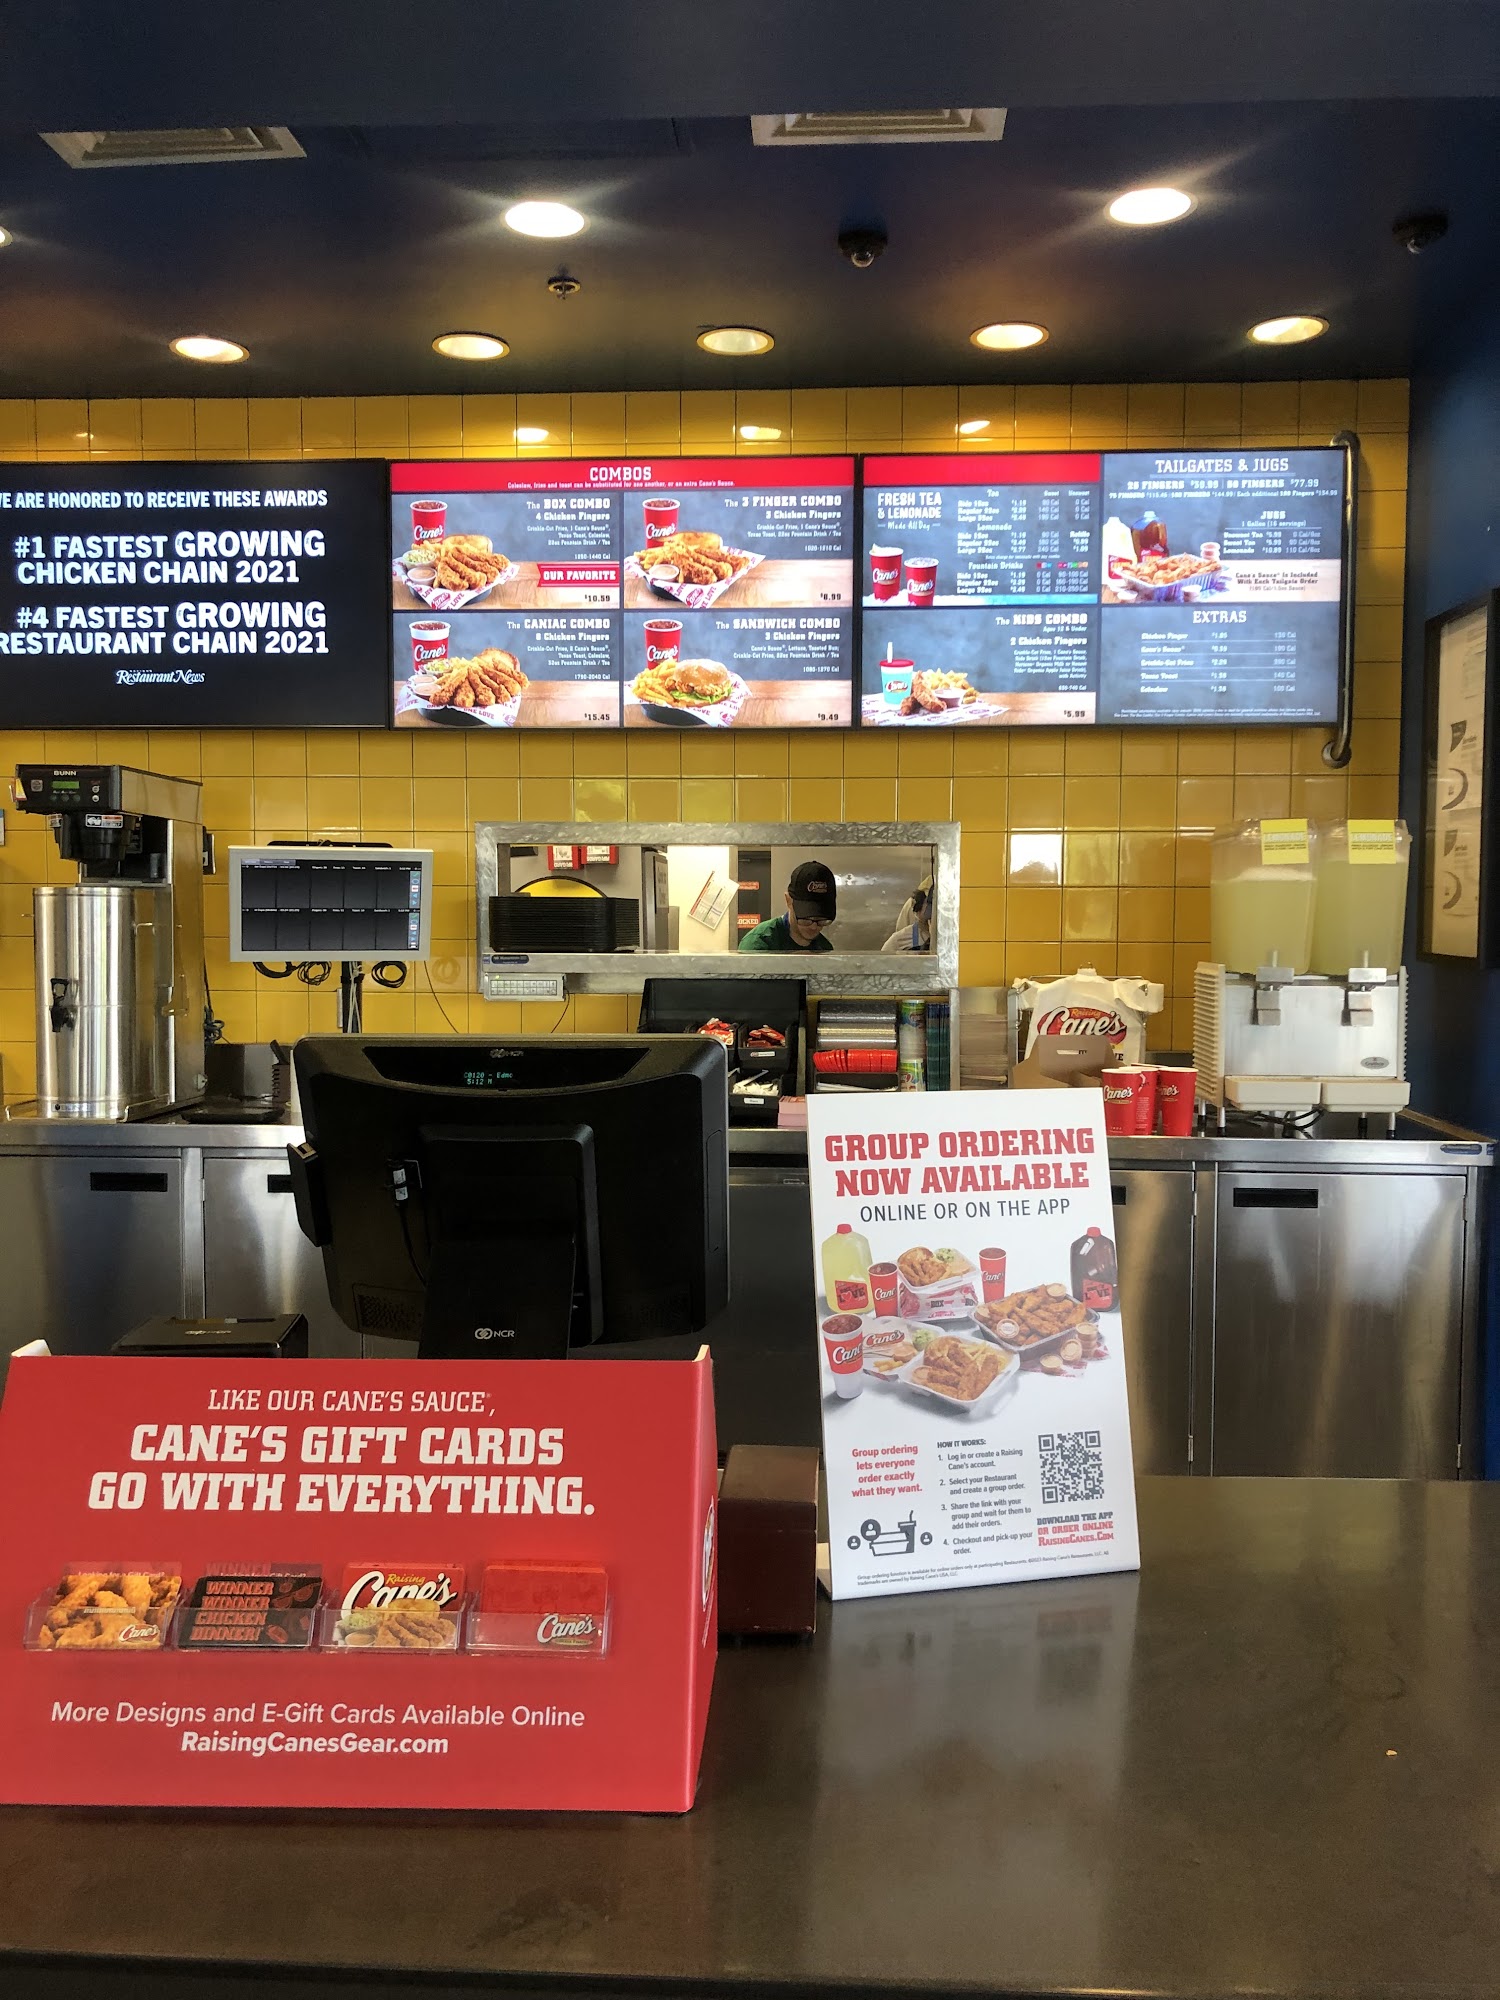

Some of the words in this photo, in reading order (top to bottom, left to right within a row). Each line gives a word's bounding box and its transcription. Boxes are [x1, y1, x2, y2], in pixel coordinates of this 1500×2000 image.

[1155, 458, 1233, 473] TAILGATES
[1238, 459, 1249, 471] &
[1252, 458, 1289, 471] JUGS
[589, 466, 651, 481] COMBOS
[1141, 480, 1184, 489] FINGERS
[1241, 479, 1285, 488] FINGERS
[15, 491, 45, 508] ARE
[49, 491, 121, 508] HONORED
[125, 491, 144, 508] TO
[147, 490, 210, 508] RECEIVE
[213, 490, 260, 507] THESE
[264, 489, 328, 506] AWARDS
[527, 501, 541, 510] The
[543, 498, 566, 509] BOX
[570, 498, 610, 509] COMBO
[725, 499, 738, 508] The
[753, 496, 797, 507] FINGER
[801, 495, 842, 506] COMBO
[878, 492, 916, 506] FRESH
[919, 492, 942, 506] TEA
[535, 512, 541, 520] 4
[544, 512, 576, 520] Chicken
[579, 512, 610, 522] Fingers
[774, 510, 807, 519] Chicken
[809, 510, 841, 520] Fingers
[878, 507, 885, 519] &
[888, 506, 942, 519] LEMONADE
[15, 536, 46, 559] #1
[55, 535, 168, 559] FASTEST
[175, 530, 326, 558] GROWING
[18, 561, 136, 585] CHICKEN
[144, 561, 228, 584] CHAIN
[236, 560, 300, 584] 2021
[543, 570, 565, 581] OUR
[566, 570, 617, 581] FAVORITE
[17, 607, 49, 629] #4
[56, 606, 169, 629] FASTEST
[176, 601, 326, 629] GROWING
[995, 617, 1010, 625] The
[1013, 614, 1042, 625] KIDS
[1046, 613, 1088, 625] COMBO
[1193, 610, 1247, 624] EXTRAS
[507, 621, 520, 629] The
[524, 618, 567, 629] CANIAC
[570, 618, 610, 629] COMBO
[716, 621, 729, 630] The
[733, 618, 796, 629] SANDWICH
[800, 618, 841, 629] COMBO
[0, 631, 166, 655] RESTAURANT
[172, 631, 257, 654] CHAIN
[264, 631, 329, 654] 2021
[544, 632, 576, 641] Chicken
[578, 632, 610, 642] Fingers
[773, 632, 806, 640] Chicken
[808, 631, 840, 641] Fingers
[1018, 636, 1052, 645] Chicken
[1054, 636, 1087, 646] Fingers
[116, 669, 174, 685] Restaurant
[173, 669, 205, 684] News
[584, 712, 611, 721] $15.45
[1040, 1006, 1127, 1036] Cane's
[825, 1133, 929, 1162] GROUP
[938, 1127, 1095, 1158] ORDERING
[835, 1167, 911, 1197] NOW
[921, 1162, 1090, 1194] AVAILABLE
[860, 1203, 927, 1223] ONLINE
[934, 1202, 958, 1220] OR
[965, 1201, 991, 1218] ON
[997, 1199, 1031, 1217] THE
[1037, 1198, 1071, 1216] APP
[493, 1330, 515, 1338] NCR
[208, 1389, 261, 1411] LIKE
[268, 1390, 315, 1411] OUR
[322, 1390, 403, 1412] CANE'S
[130, 1424, 288, 1463] CANE'S
[301, 1426, 407, 1464] GIFT
[419, 1427, 564, 1465] CARDS
[852, 1448, 879, 1458] Group
[881, 1444, 918, 1455] ordering
[937, 1441, 952, 1449] HOW
[961, 1439, 986, 1447] WORKS:
[856, 1461, 873, 1470] lets
[875, 1458, 915, 1469] everyone
[948, 1462, 969, 1470] Cane's
[970, 1460, 996, 1468] account.
[858, 1474, 881, 1483] order
[884, 1471, 915, 1481] exactly
[969, 1477, 983, 1485] your
[984, 1473, 1017, 1482] Restaurant
[88, 1471, 148, 1510] GO
[161, 1473, 287, 1511] WITH
[295, 1473, 595, 1515] EVERYTHING.
[852, 1487, 874, 1497] what
[876, 1486, 896, 1496] they
[898, 1484, 923, 1494] want.
[963, 1486, 982, 1494] create
[989, 1485, 1006, 1493] group
[951, 1502, 968, 1510] Share
[1037, 1514, 1080, 1525] DOWNLOAD
[1081, 1513, 1096, 1521] THE
[1098, 1511, 1113, 1520] APP
[386, 1573, 425, 1585] Raising
[206, 1581, 274, 1595] WINNER
[341, 1570, 458, 1620] Cane's
[201, 1596, 270, 1610] WINNER
[195, 1611, 267, 1625] CHICKEN
[118, 1624, 159, 1643] Cane's
[190, 1626, 261, 1642] DINNER!
[537, 1615, 596, 1643] Cane's
[51, 1702, 109, 1723] More
[116, 1702, 206, 1727] Designs
[213, 1703, 255, 1722] and
[262, 1703, 324, 1724] E-Gift
[330, 1703, 395, 1725] Cards
[402, 1704, 505, 1726] Available
[511, 1705, 585, 1727] Online
[181, 1731, 449, 1757] RaisingCanesGear.com
